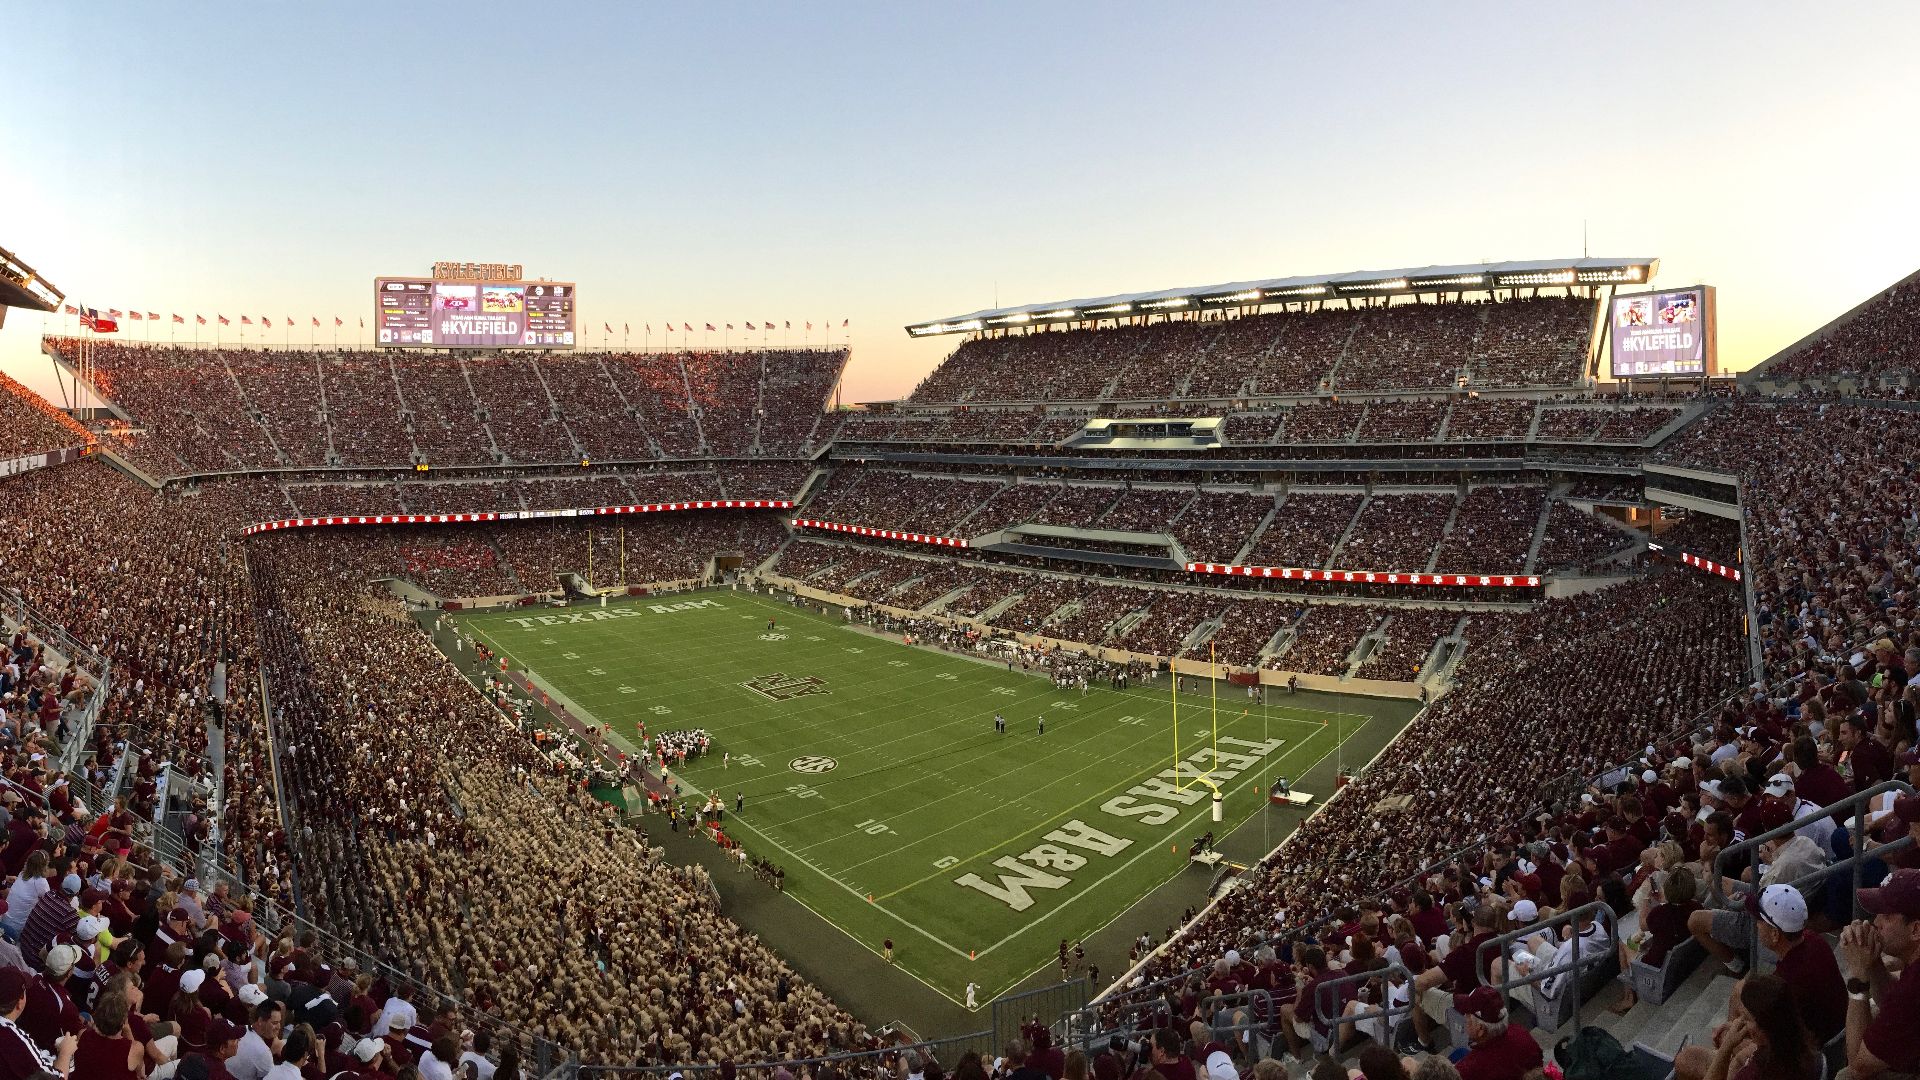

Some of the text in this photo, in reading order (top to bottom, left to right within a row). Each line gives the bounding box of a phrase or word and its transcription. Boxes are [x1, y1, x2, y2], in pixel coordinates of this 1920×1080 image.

[435, 262, 522, 281] KYLE FIELD
[441, 320, 518, 335] #KYLEFIELD
[1622, 333, 1693, 352] #KYLEFIELD
[505, 608, 642, 628] TEXAS
[1099, 735, 1287, 826] TEXAS
[854, 818, 889, 835] 10
[953, 819, 1136, 913] A&M
